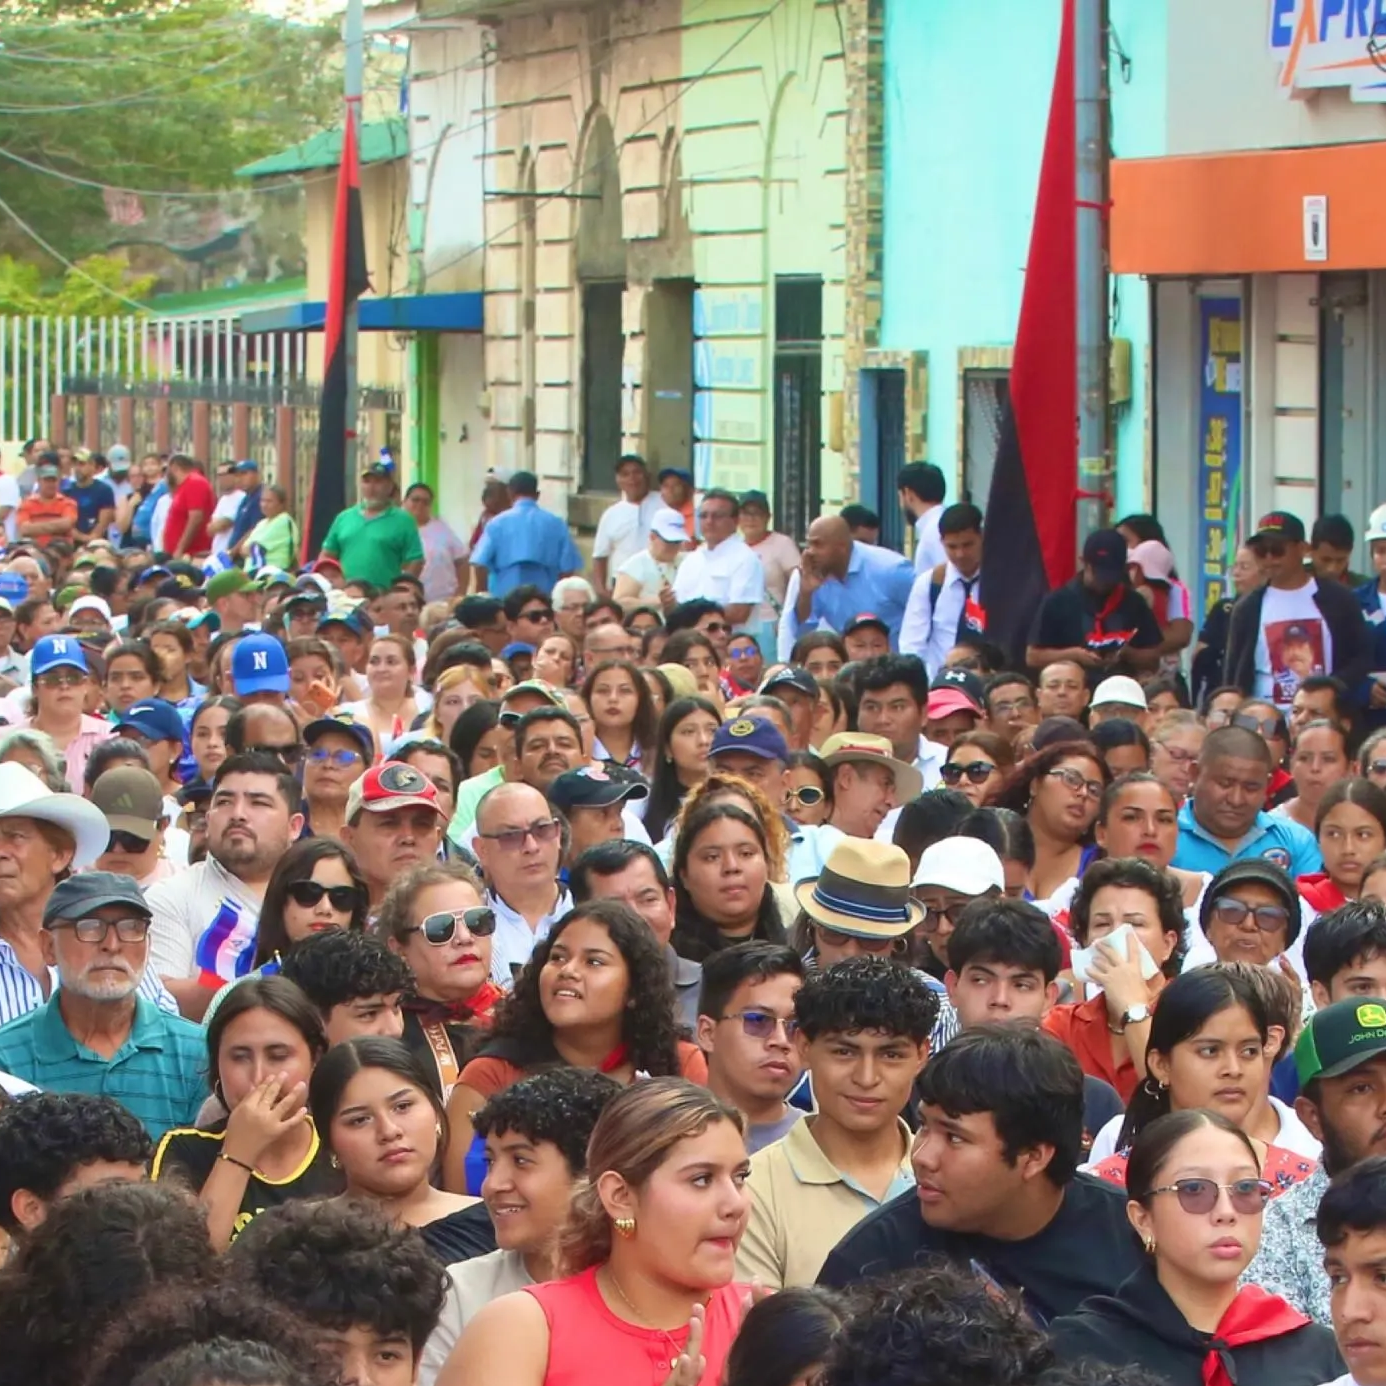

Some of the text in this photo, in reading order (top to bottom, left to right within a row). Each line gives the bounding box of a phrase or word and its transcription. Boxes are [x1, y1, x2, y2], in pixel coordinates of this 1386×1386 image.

[52, 638, 67, 654] N
[252, 651, 268, 670] N
[1348, 1032, 1375, 1045] JOHN
